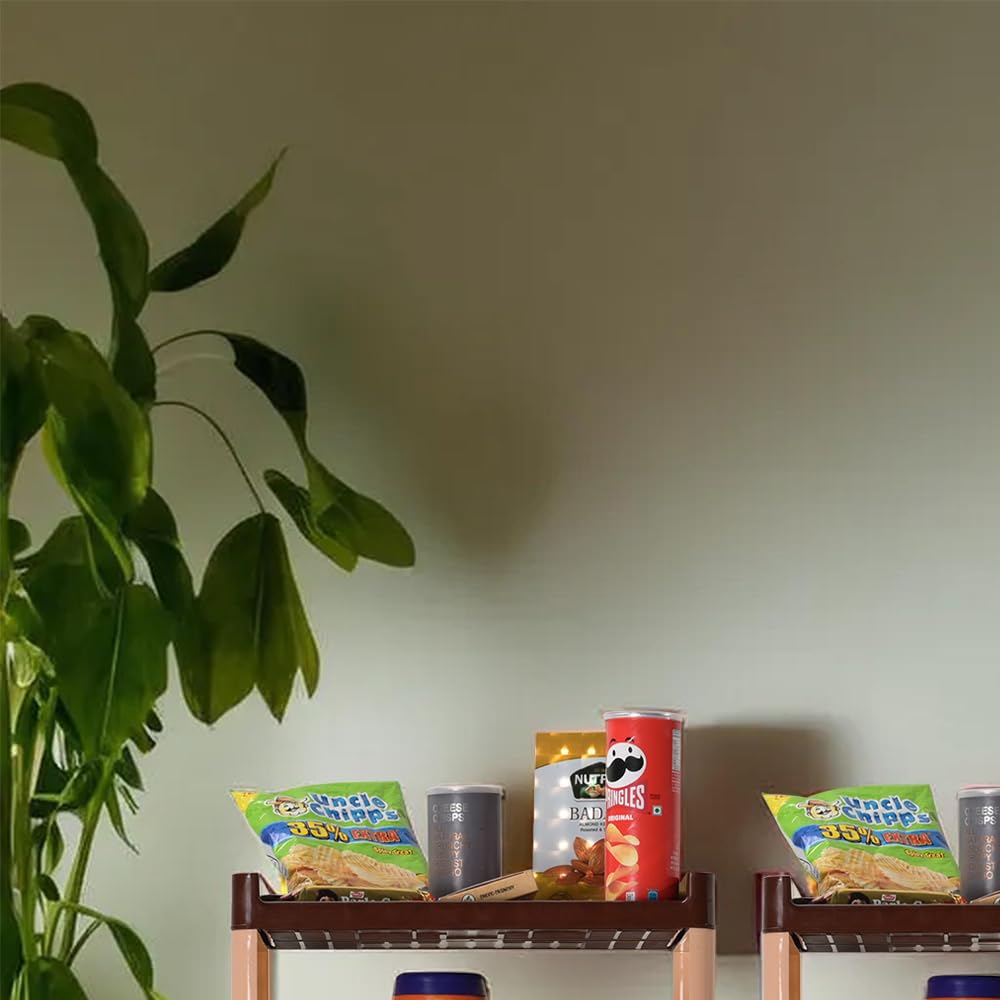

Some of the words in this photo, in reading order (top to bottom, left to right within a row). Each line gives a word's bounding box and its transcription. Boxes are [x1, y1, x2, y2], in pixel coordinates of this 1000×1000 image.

[309, 792, 387, 809] Uncle
[605, 784, 645, 809] RINGLES
[841, 795, 919, 812] Uncle
[309, 802, 399, 824] Chipps
[570, 807, 606, 820] BAD
[841, 805, 931, 827] Chipps
[287, 821, 349, 843] 35%
[351, 829, 401, 843] EXTRA
[819, 824, 881, 846] 35%
[883, 832, 933, 846] EXTRA
